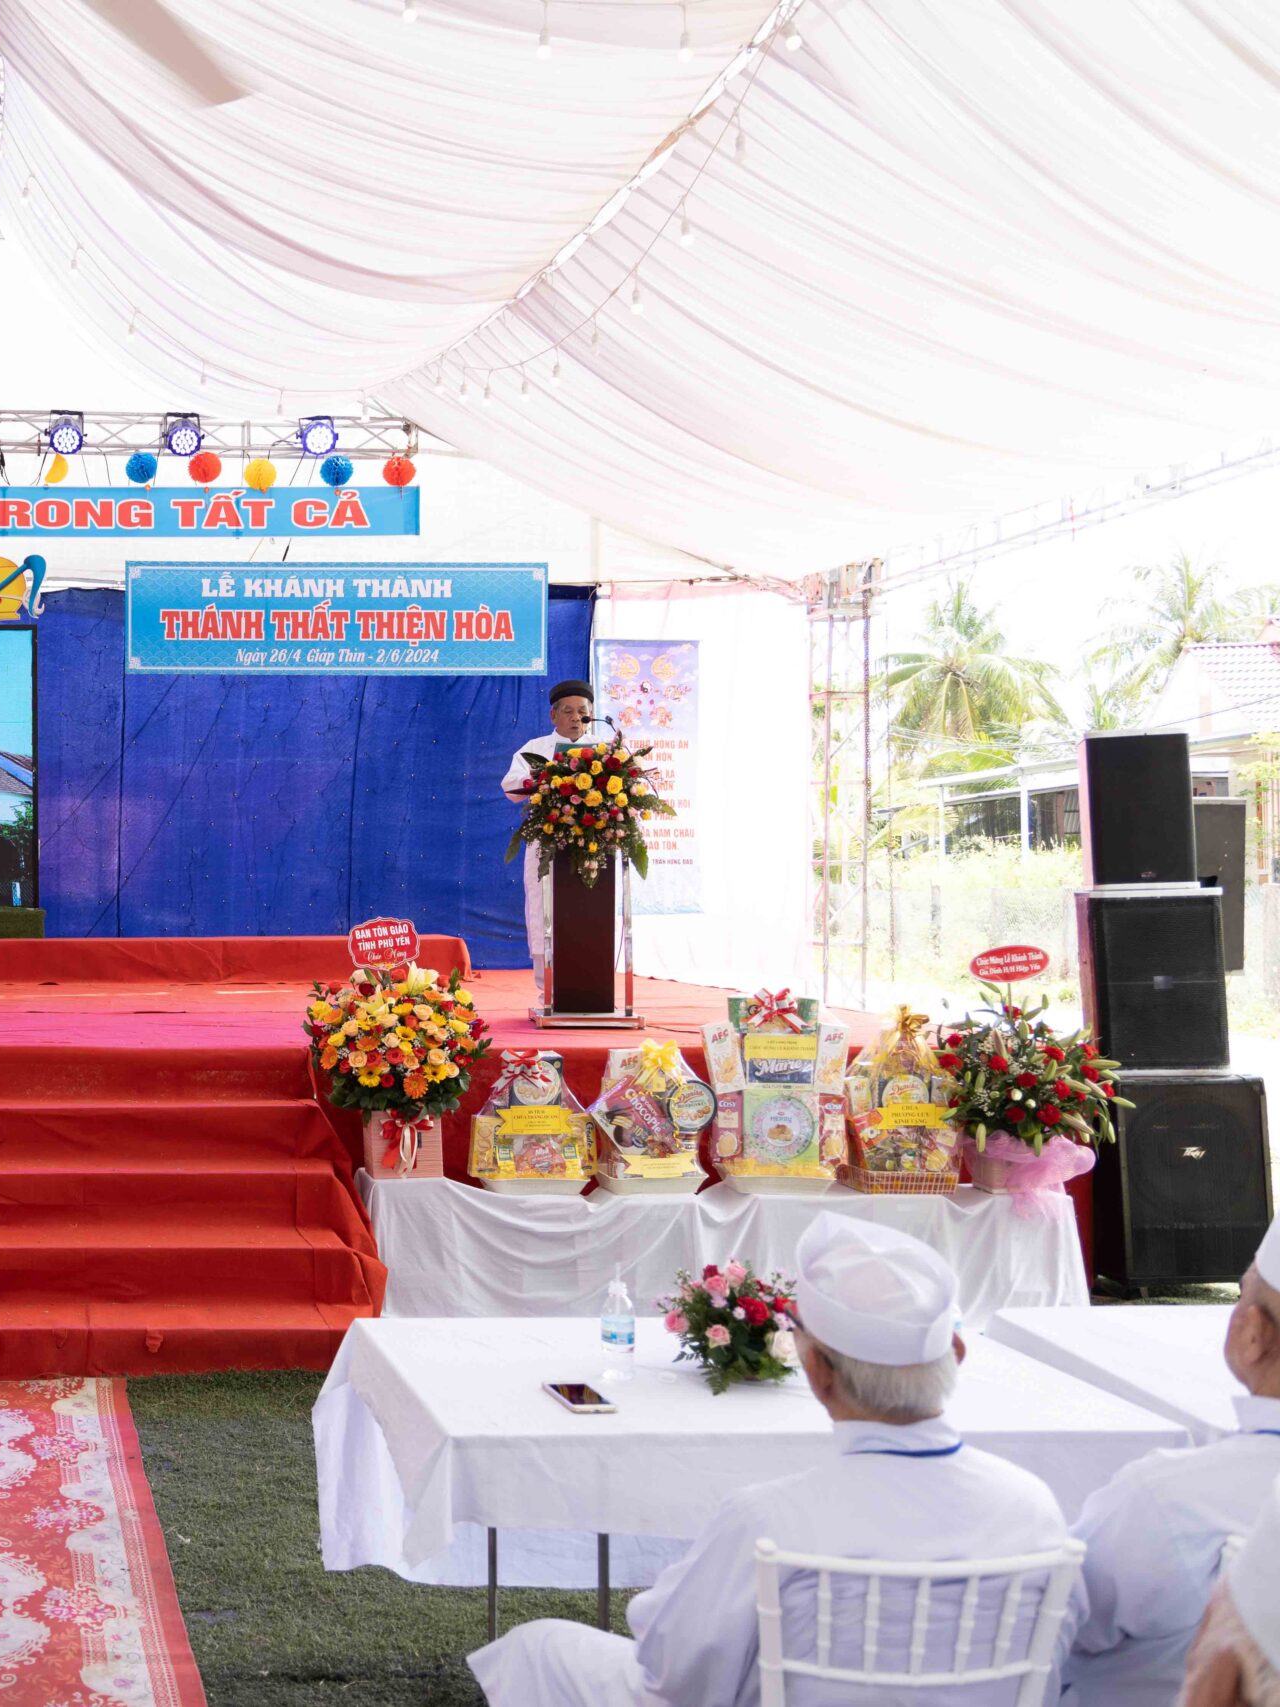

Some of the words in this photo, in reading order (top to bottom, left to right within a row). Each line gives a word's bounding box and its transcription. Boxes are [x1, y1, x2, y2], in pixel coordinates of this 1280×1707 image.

[171, 490, 286, 529] TẤT
[291, 490, 370, 529] CẢ
[201, 572, 236, 598] LỄ
[243, 574, 345, 599] KHÁNH
[352, 574, 453, 599] THÀNH
[160, 604, 265, 641] THÁNH
[270, 600, 350, 641] THẤT
[356, 604, 447, 646] THIỆN
[452, 603, 514, 642] HÒA
[236, 648, 267, 665] Ngày
[270, 648, 301, 664] 26/4
[306, 648, 335, 665] Giáp
[376, 648, 439, 664] 2/6/2024
[355, 929, 371, 939] BAN
[373, 926, 388, 937] TÔN
[389, 923, 409, 935] GIÁO
[711, 1028, 729, 1043] AFC
[824, 1032, 844, 1043] AFC
[621, 1055, 639, 1068] AFC
[754, 1058, 803, 1077] Marie
